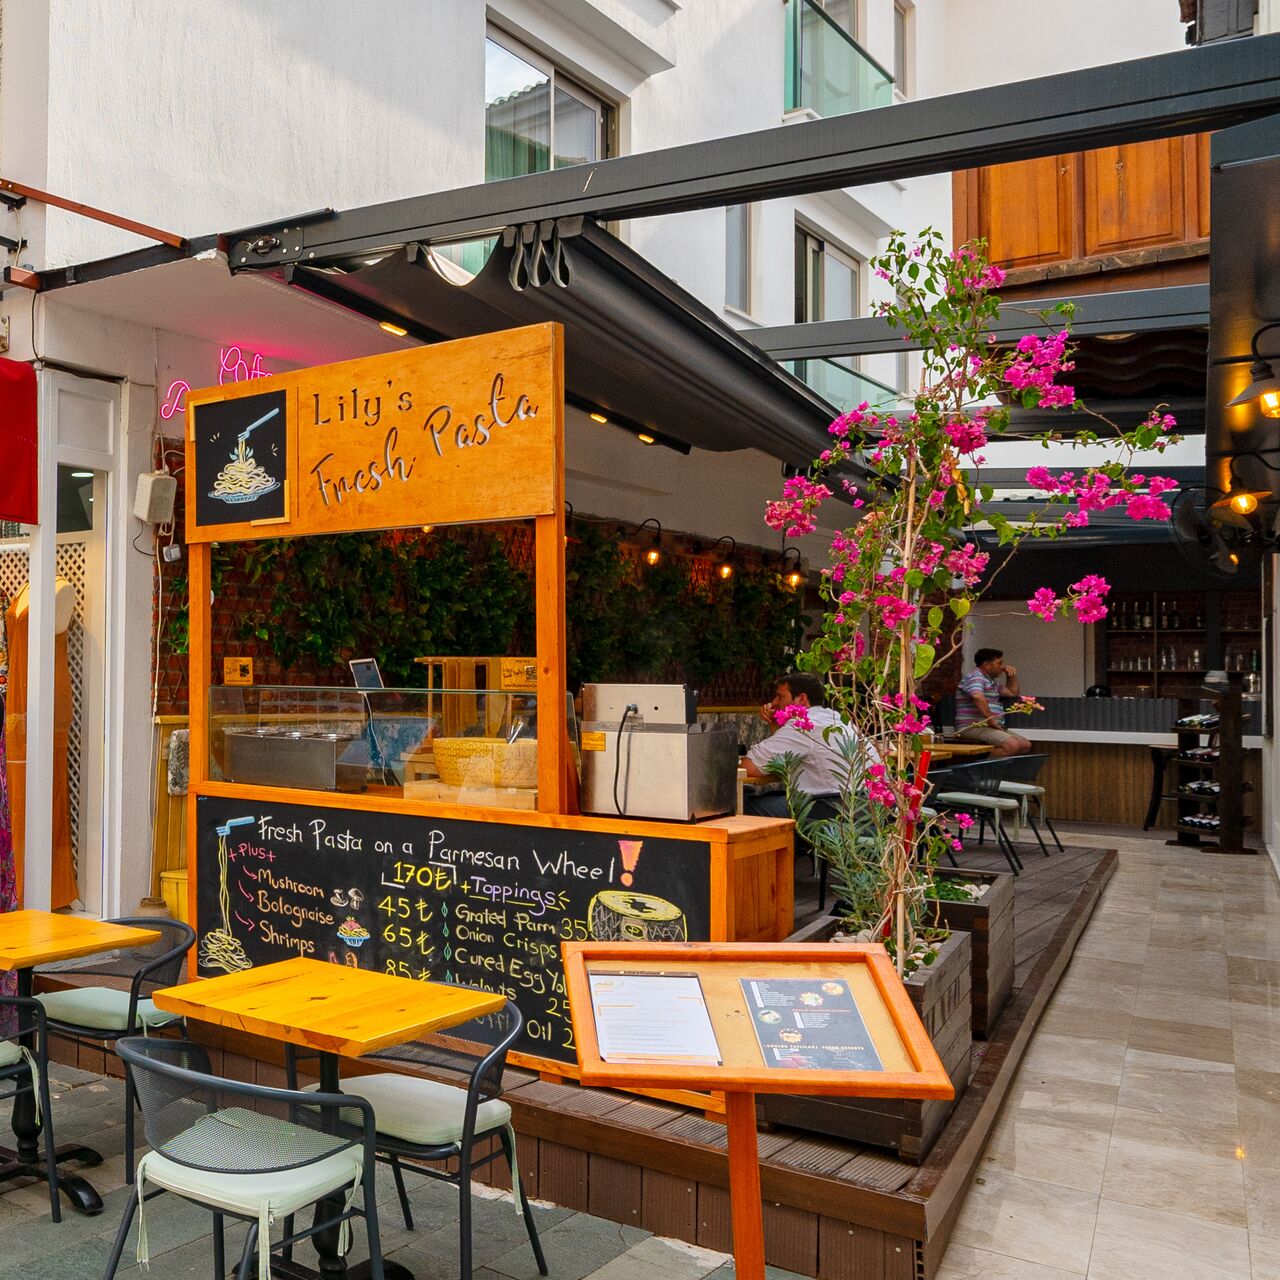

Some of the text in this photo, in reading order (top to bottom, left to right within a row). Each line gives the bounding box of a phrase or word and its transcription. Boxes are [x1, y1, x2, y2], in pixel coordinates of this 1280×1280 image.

[313, 380, 413, 427] Lily's
[310, 372, 539, 506] Fresh Pasta
[258, 815, 303, 843] Fresh
[309, 819, 363, 851] Pasta
[374, 841, 393, 855] on
[402, 842, 413, 855] a
[428, 829, 521, 871] Parmesan
[258, 868, 325, 899] Mushroom
[257, 890, 334, 928] Bolognaise
[455, 904, 506, 929] Grated
[514, 911, 556, 934] Parm
[259, 920, 315, 957] Shrimps
[456, 925, 557, 965] Onion Crisps
[454, 948, 567, 997] Cured Egg Yol
[527, 1019, 551, 1041] Oil
[562, 1028, 576, 1050] 2
